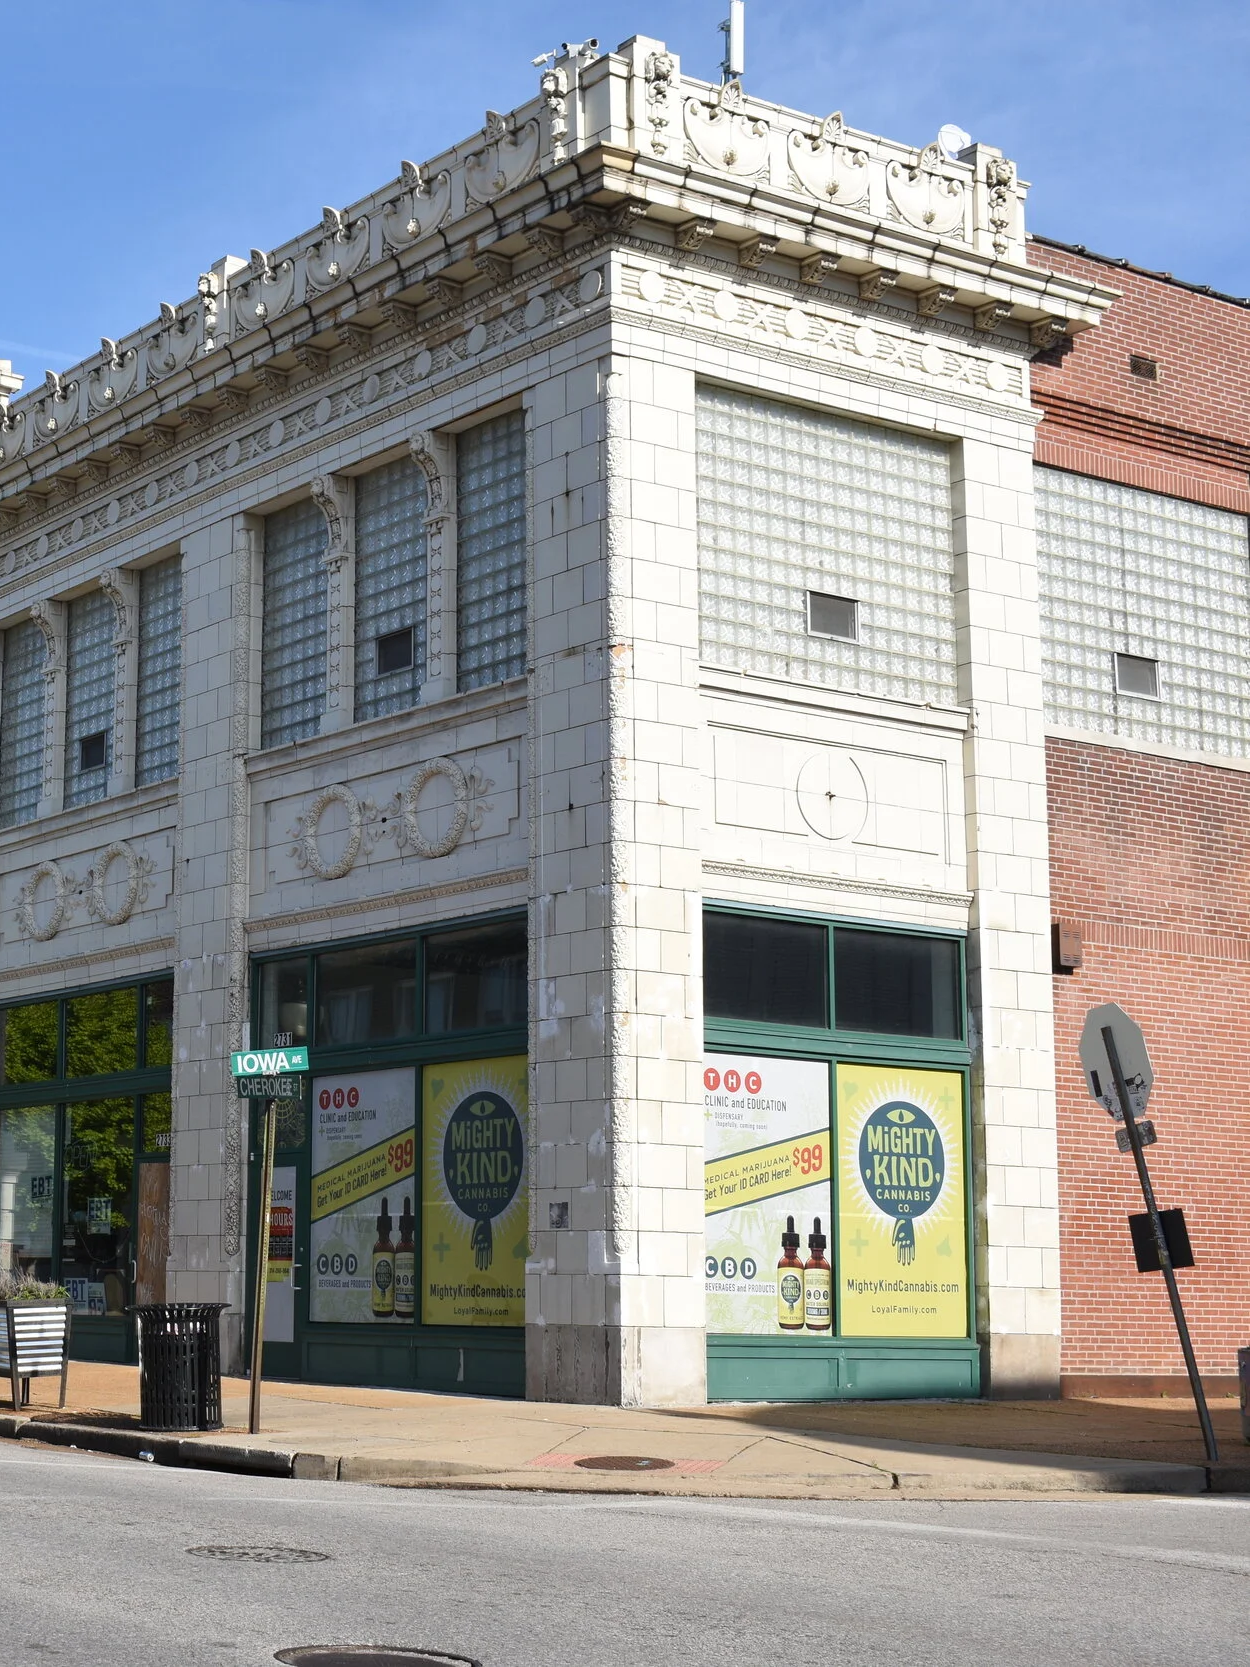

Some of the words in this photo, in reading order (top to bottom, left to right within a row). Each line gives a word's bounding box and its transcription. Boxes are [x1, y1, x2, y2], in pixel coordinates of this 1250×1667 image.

[275, 1033, 292, 1046] 2731
[237, 1052, 290, 1073] IOWA
[292, 1055, 302, 1064] AVE
[240, 1078, 292, 1096] CHEROKEE
[704, 1095, 729, 1107] CLINIC
[731, 1098, 744, 1109] and
[747, 1098, 787, 1112] EDUCATION
[319, 1112, 336, 1123] CLINIC
[337, 1113, 347, 1122] and
[348, 1110, 377, 1121] EDUCATION
[714, 1112, 743, 1120] DISPENSARY
[387, 1139, 414, 1173] $99
[792, 1144, 823, 1175] $99
[317, 1174, 346, 1193] MEDICAL
[347, 1154, 386, 1177] MARIJUANA
[456, 1151, 512, 1184] KIND
[704, 1169, 739, 1185] MEDICAL
[742, 1155, 790, 1174] MARIJUANA
[873, 1155, 934, 1188] KIND
[31, 1175, 52, 1197] EBT
[317, 1194, 328, 1208] Get
[329, 1188, 344, 1201] Your
[344, 1182, 351, 1195] ID
[352, 1174, 369, 1190] CARD
[370, 1164, 387, 1183] Here!
[704, 1188, 716, 1200] Get
[719, 1183, 738, 1196] Your
[739, 1178, 748, 1190] ID
[749, 1172, 770, 1187] CARD
[771, 1165, 792, 1180] Here!
[270, 1190, 293, 1201] ELCOME
[457, 1187, 509, 1200] CANNABIS
[876, 1188, 931, 1202] CANNABIS
[89, 1199, 110, 1220] EBT
[477, 1203, 492, 1213] CO.
[897, 1203, 913, 1213] CO.
[318, 1279, 341, 1288] BEVERAGES
[350, 1280, 372, 1289] PRODUCTS
[430, 1283, 525, 1300] MightyKindCannabis.co
[705, 1282, 736, 1292] BEVERAGES
[748, 1284, 776, 1293] PRODUCTS
[847, 1278, 959, 1294] MightyKindCannabis.com
[453, 1306, 509, 1318] LoyalFamily.com
[871, 1305, 937, 1319] LoyalFamily.com
